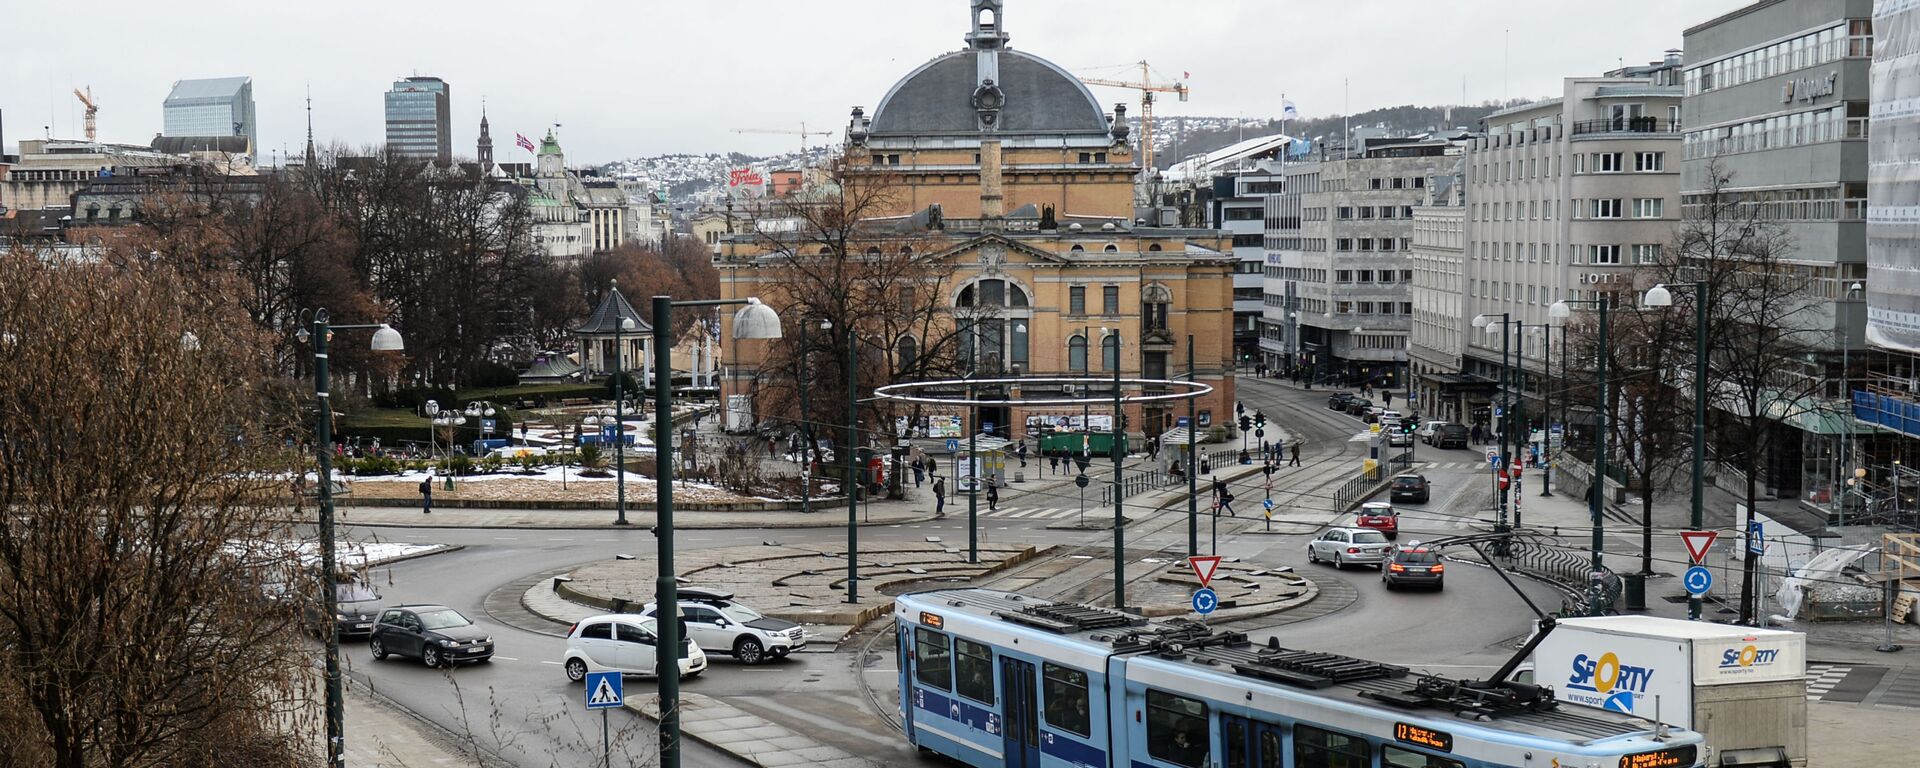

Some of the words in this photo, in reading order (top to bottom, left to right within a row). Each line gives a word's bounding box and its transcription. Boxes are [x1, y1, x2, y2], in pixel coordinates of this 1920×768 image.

[1721, 645, 1779, 666] SPORTY
[1569, 652, 1654, 693] SPORTY
[1398, 724, 1407, 739] 12
